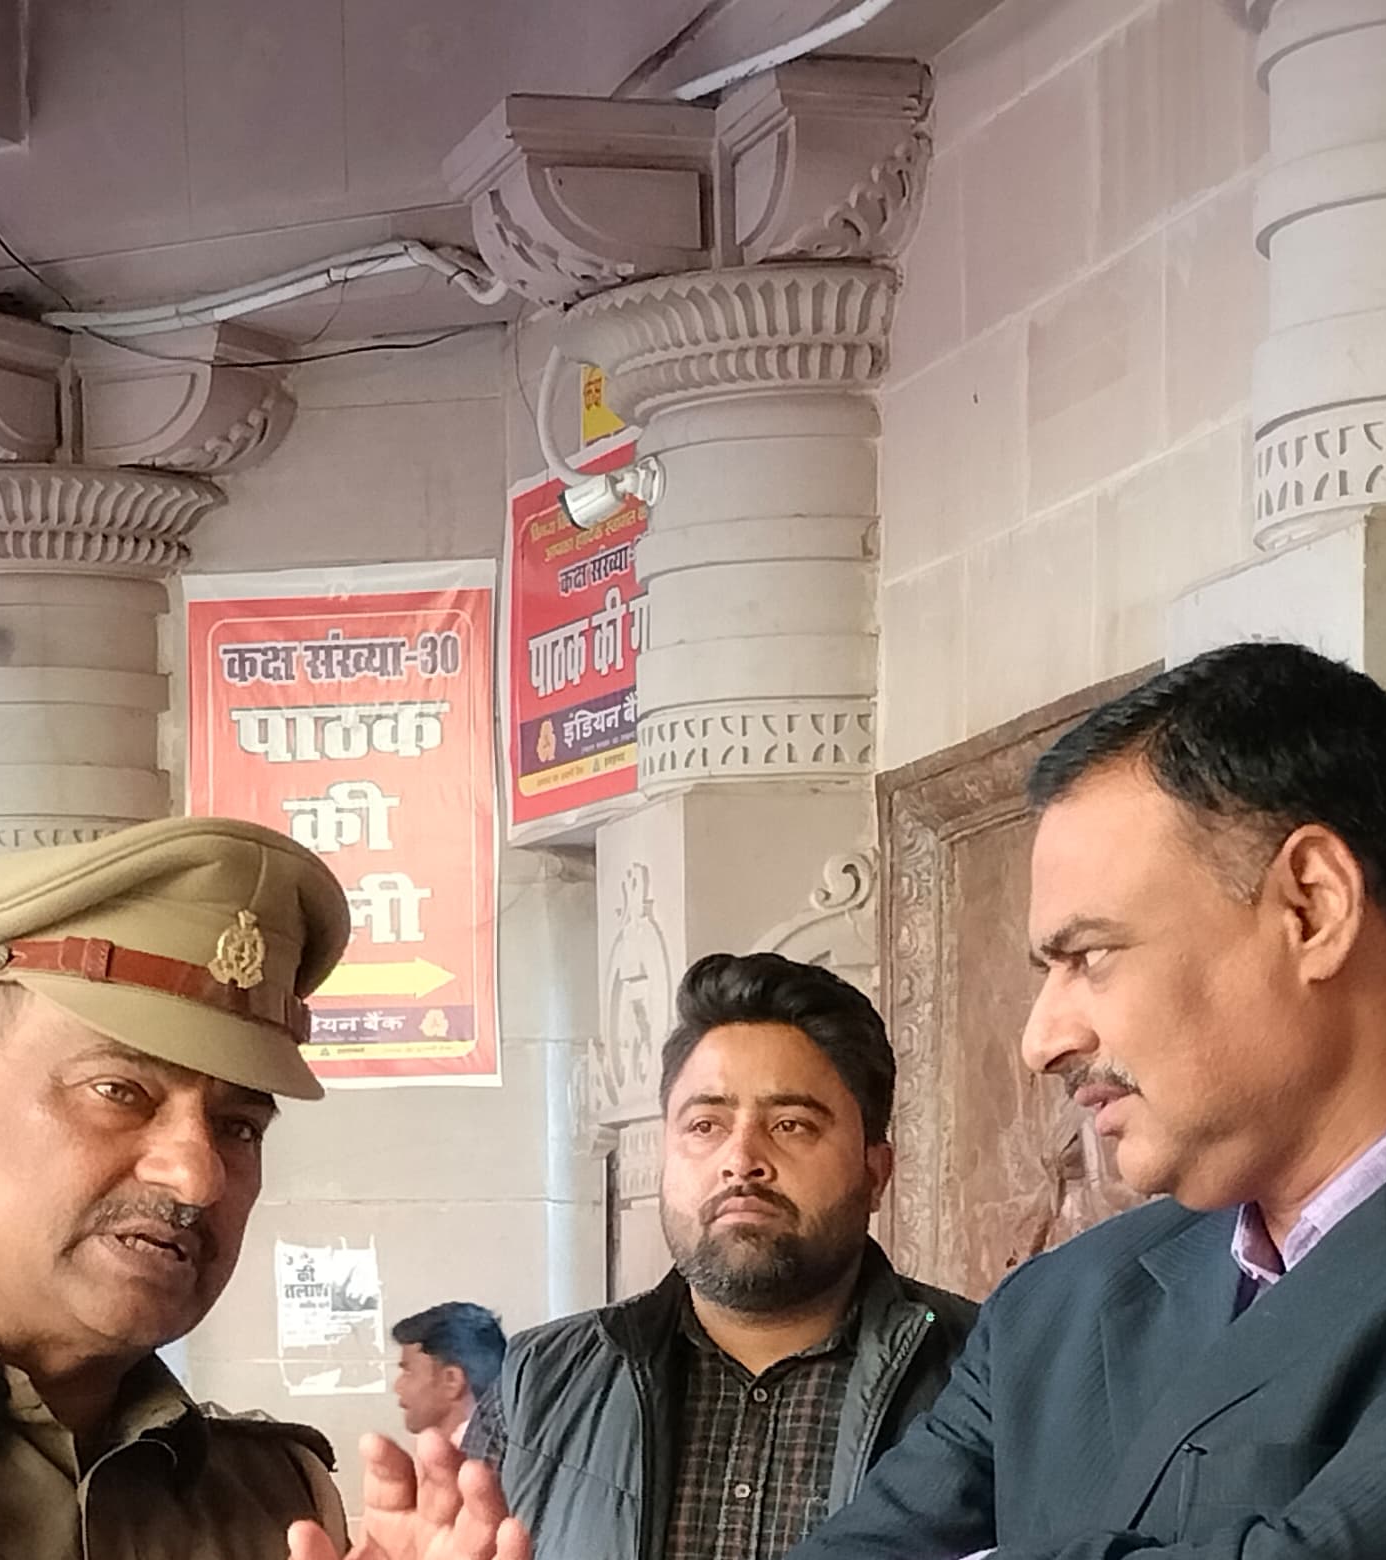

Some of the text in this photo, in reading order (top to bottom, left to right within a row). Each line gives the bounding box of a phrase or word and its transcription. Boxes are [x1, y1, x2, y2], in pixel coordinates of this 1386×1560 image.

[559, 562, 587, 594] कक्ष
[221, 630, 461, 685] कक्ष संख्या-30
[528, 617, 590, 698] पाठक
[591, 586, 627, 676] की
[230, 702, 451, 762] पाठक
[562, 704, 622, 748] इंडियन
[282, 779, 402, 853] की
[346, 872, 435, 944] ली
[362, 1009, 406, 1032] बैंक
